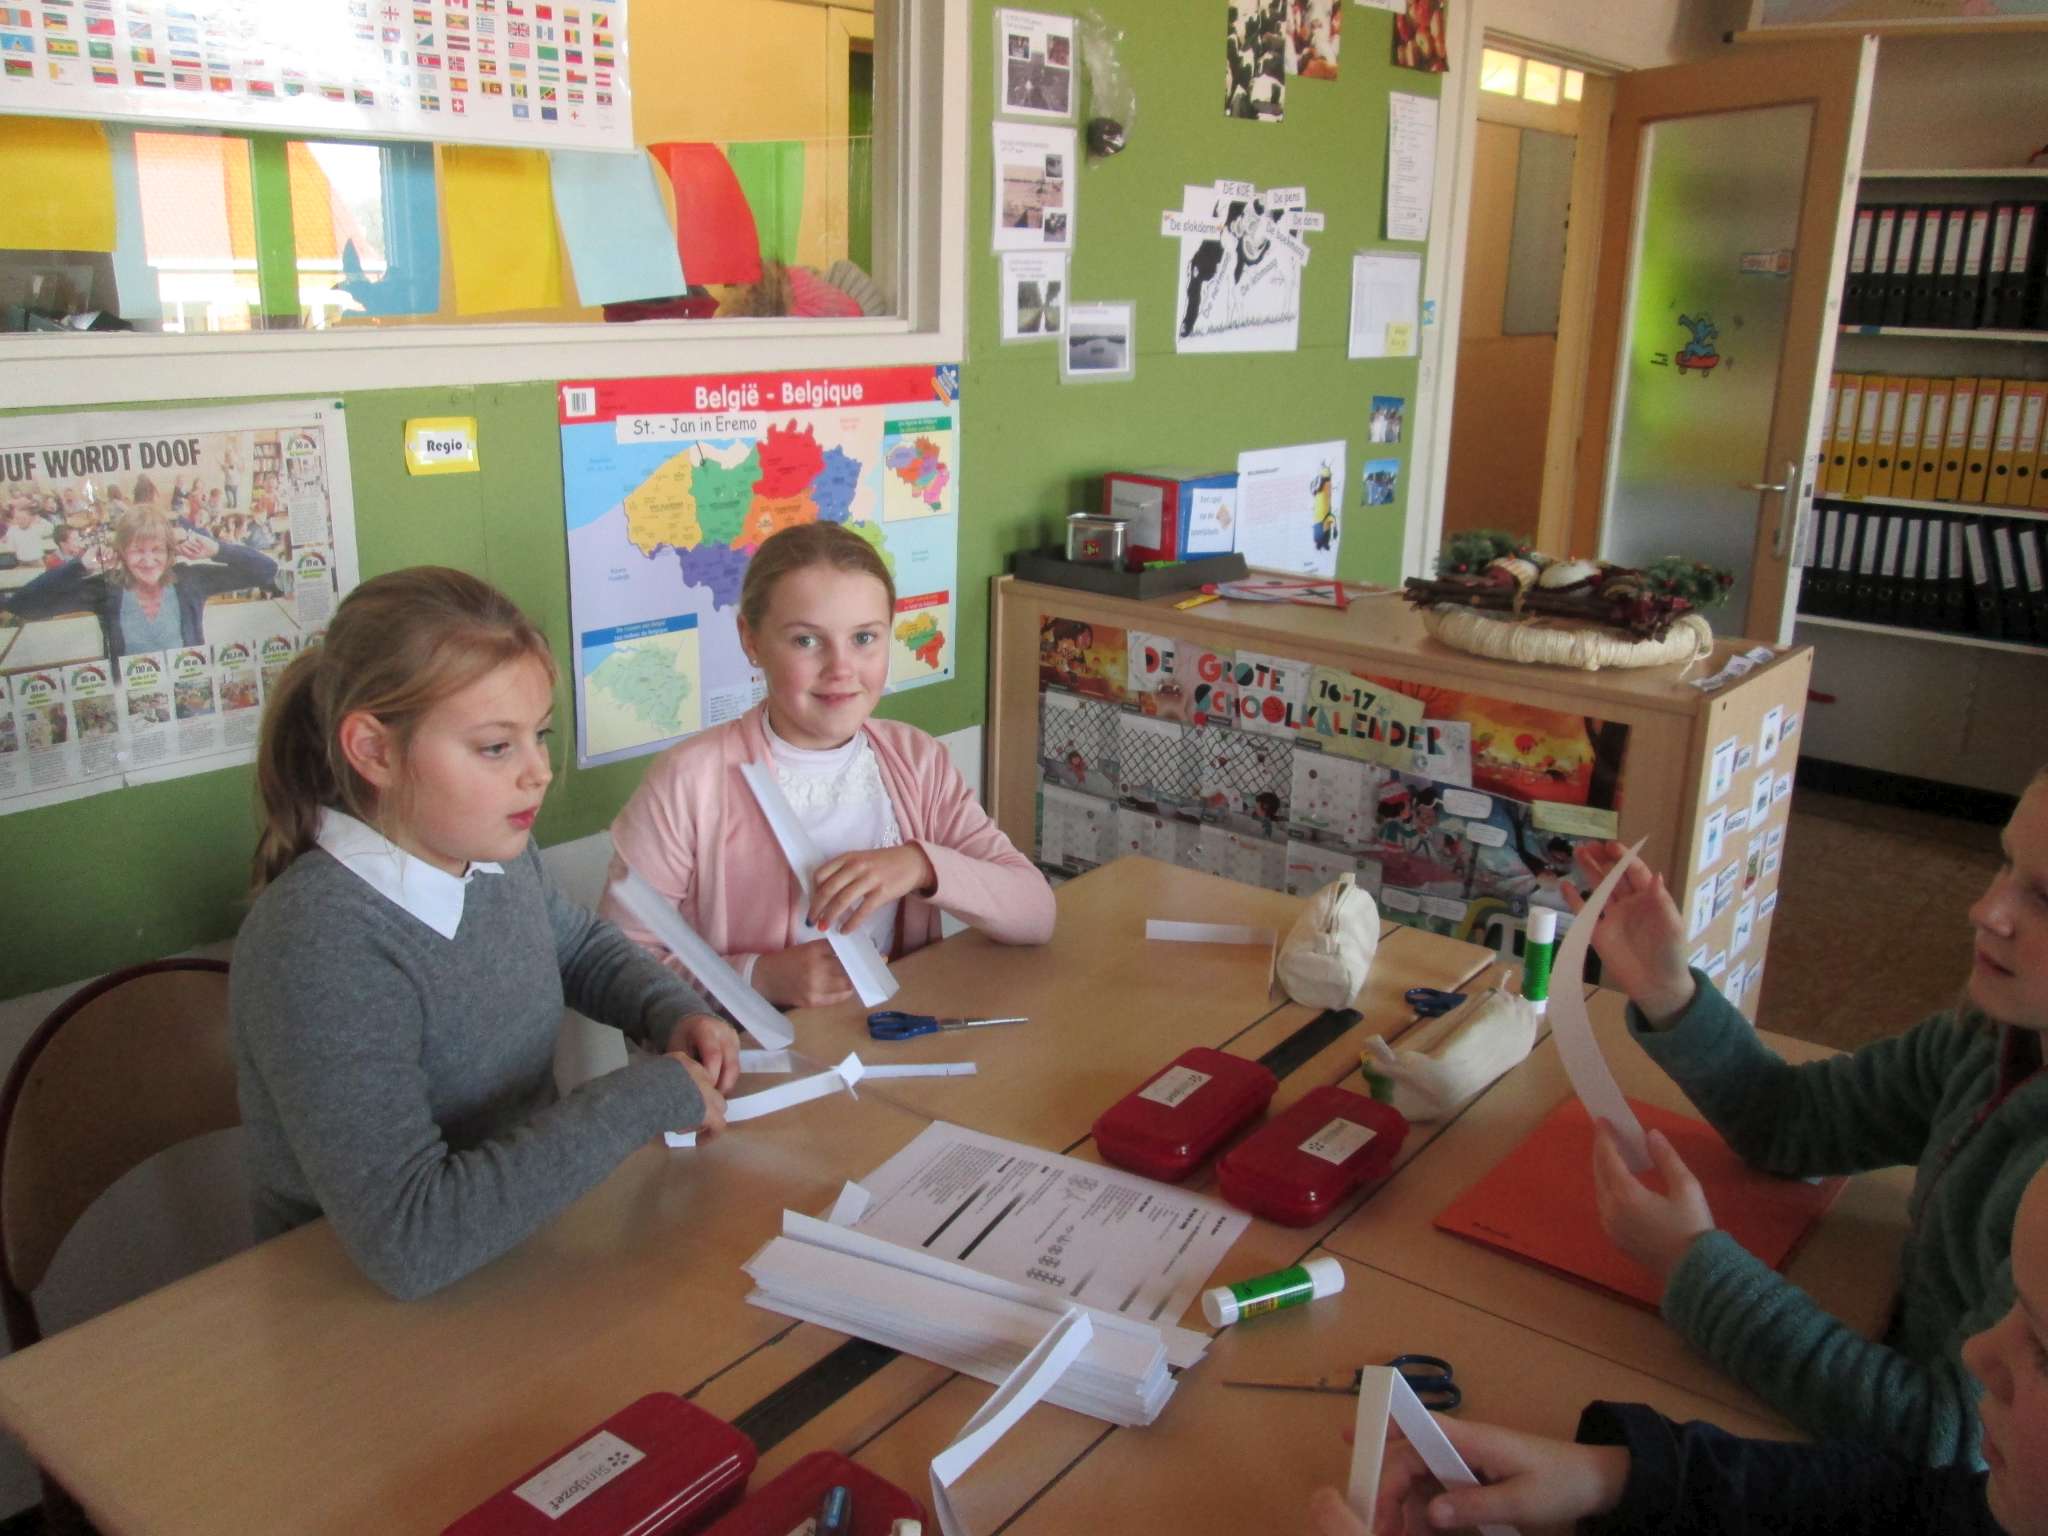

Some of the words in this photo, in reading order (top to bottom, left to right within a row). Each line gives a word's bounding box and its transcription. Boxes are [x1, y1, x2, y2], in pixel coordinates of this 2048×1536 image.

[695, 383, 760, 412] België
[782, 380, 864, 407] Belgique
[633, 419, 655, 435] St.
[671, 418, 696, 434] Jan
[700, 416, 712, 432] in
[716, 415, 757, 432] Eremo
[43, 443, 132, 479] WORDT
[139, 438, 201, 469] DOOF
[427, 438, 463, 454] Regio
[1145, 647, 1175, 673] DE
[1198, 653, 1286, 692] GROTE
[1319, 680, 1376, 711] 16-17
[1194, 683, 1446, 755] SCHOOLKALENDER
